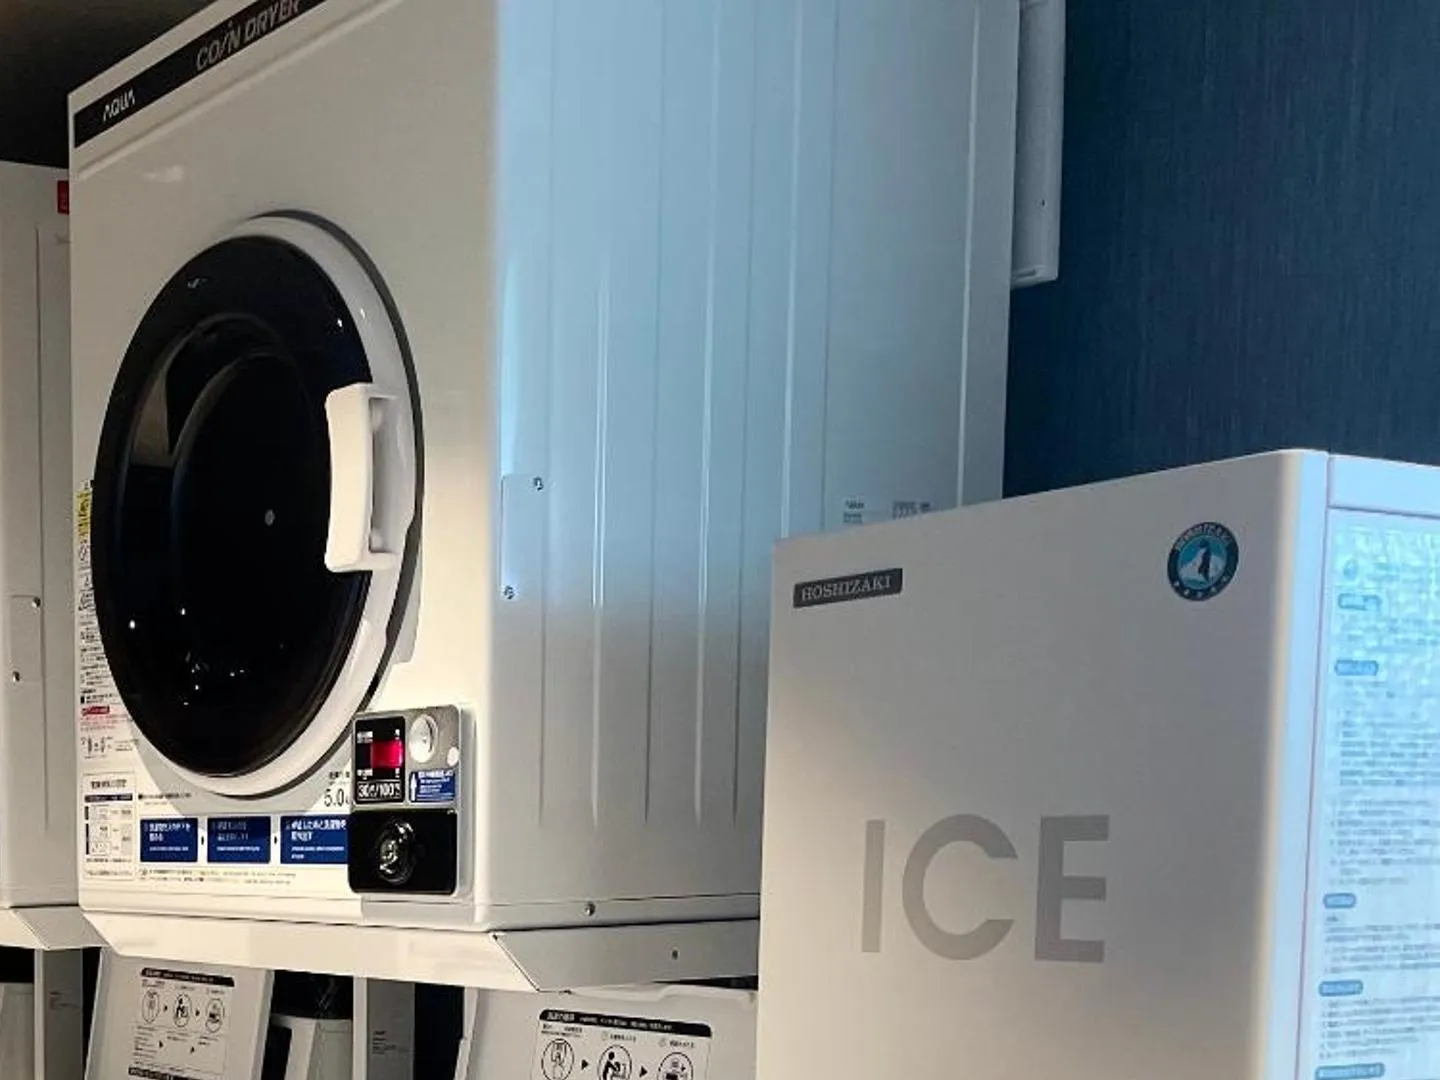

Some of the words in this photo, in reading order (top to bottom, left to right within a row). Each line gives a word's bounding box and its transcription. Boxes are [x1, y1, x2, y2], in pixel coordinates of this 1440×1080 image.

[103, 88, 136, 121] AQUA
[196, 19, 241, 71] COIN
[801, 575, 891, 601] HOSHIZAKI
[861, 813, 1110, 962] ICE
